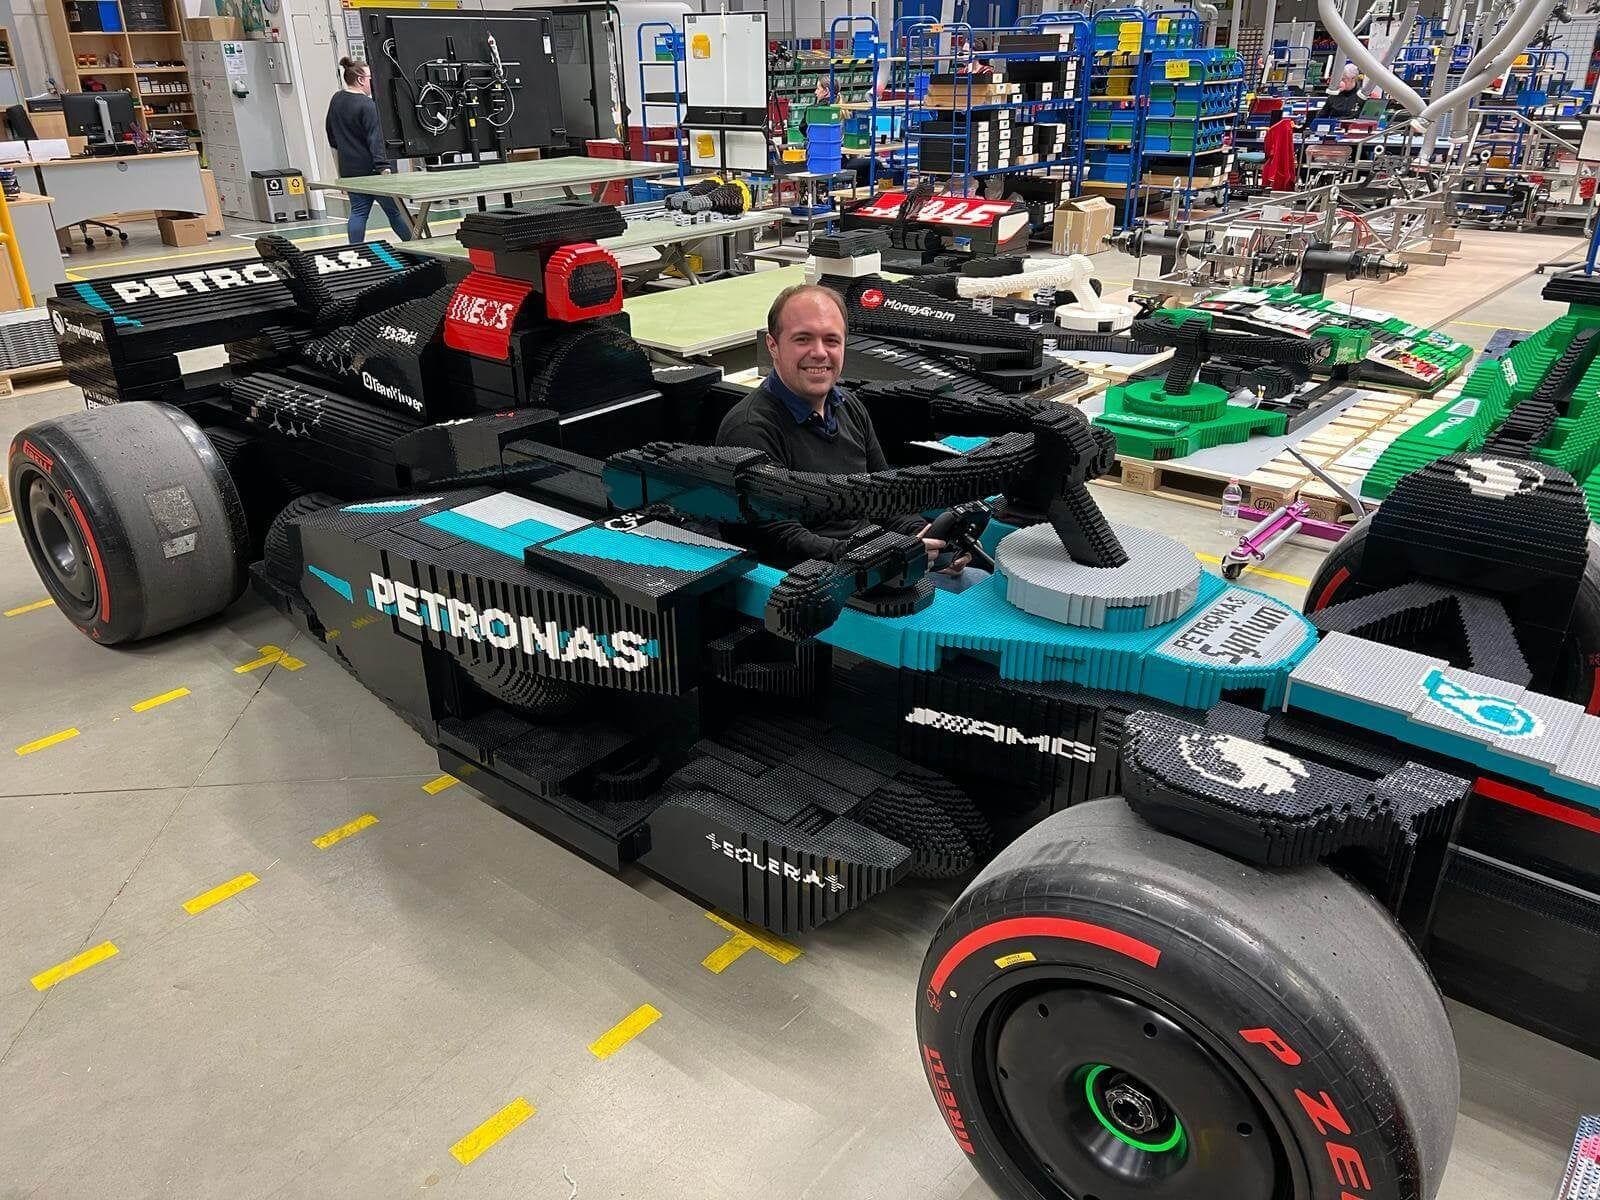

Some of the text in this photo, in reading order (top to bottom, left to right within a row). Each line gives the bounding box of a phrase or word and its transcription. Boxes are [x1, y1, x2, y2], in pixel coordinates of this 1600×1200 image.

[111, 250, 372, 304] PETROAS
[449, 293, 514, 330] INEOS
[884, 299, 956, 322] MoneyGram
[370, 572, 650, 672] PETRONAS
[1173, 597, 1247, 651] PETRONAS
[1199, 606, 1290, 665] Syntium
[722, 840, 826, 889] SOLERA
[923, 1043, 976, 1156] PIRELLI
[1238, 1027, 1372, 1200] P ZE
